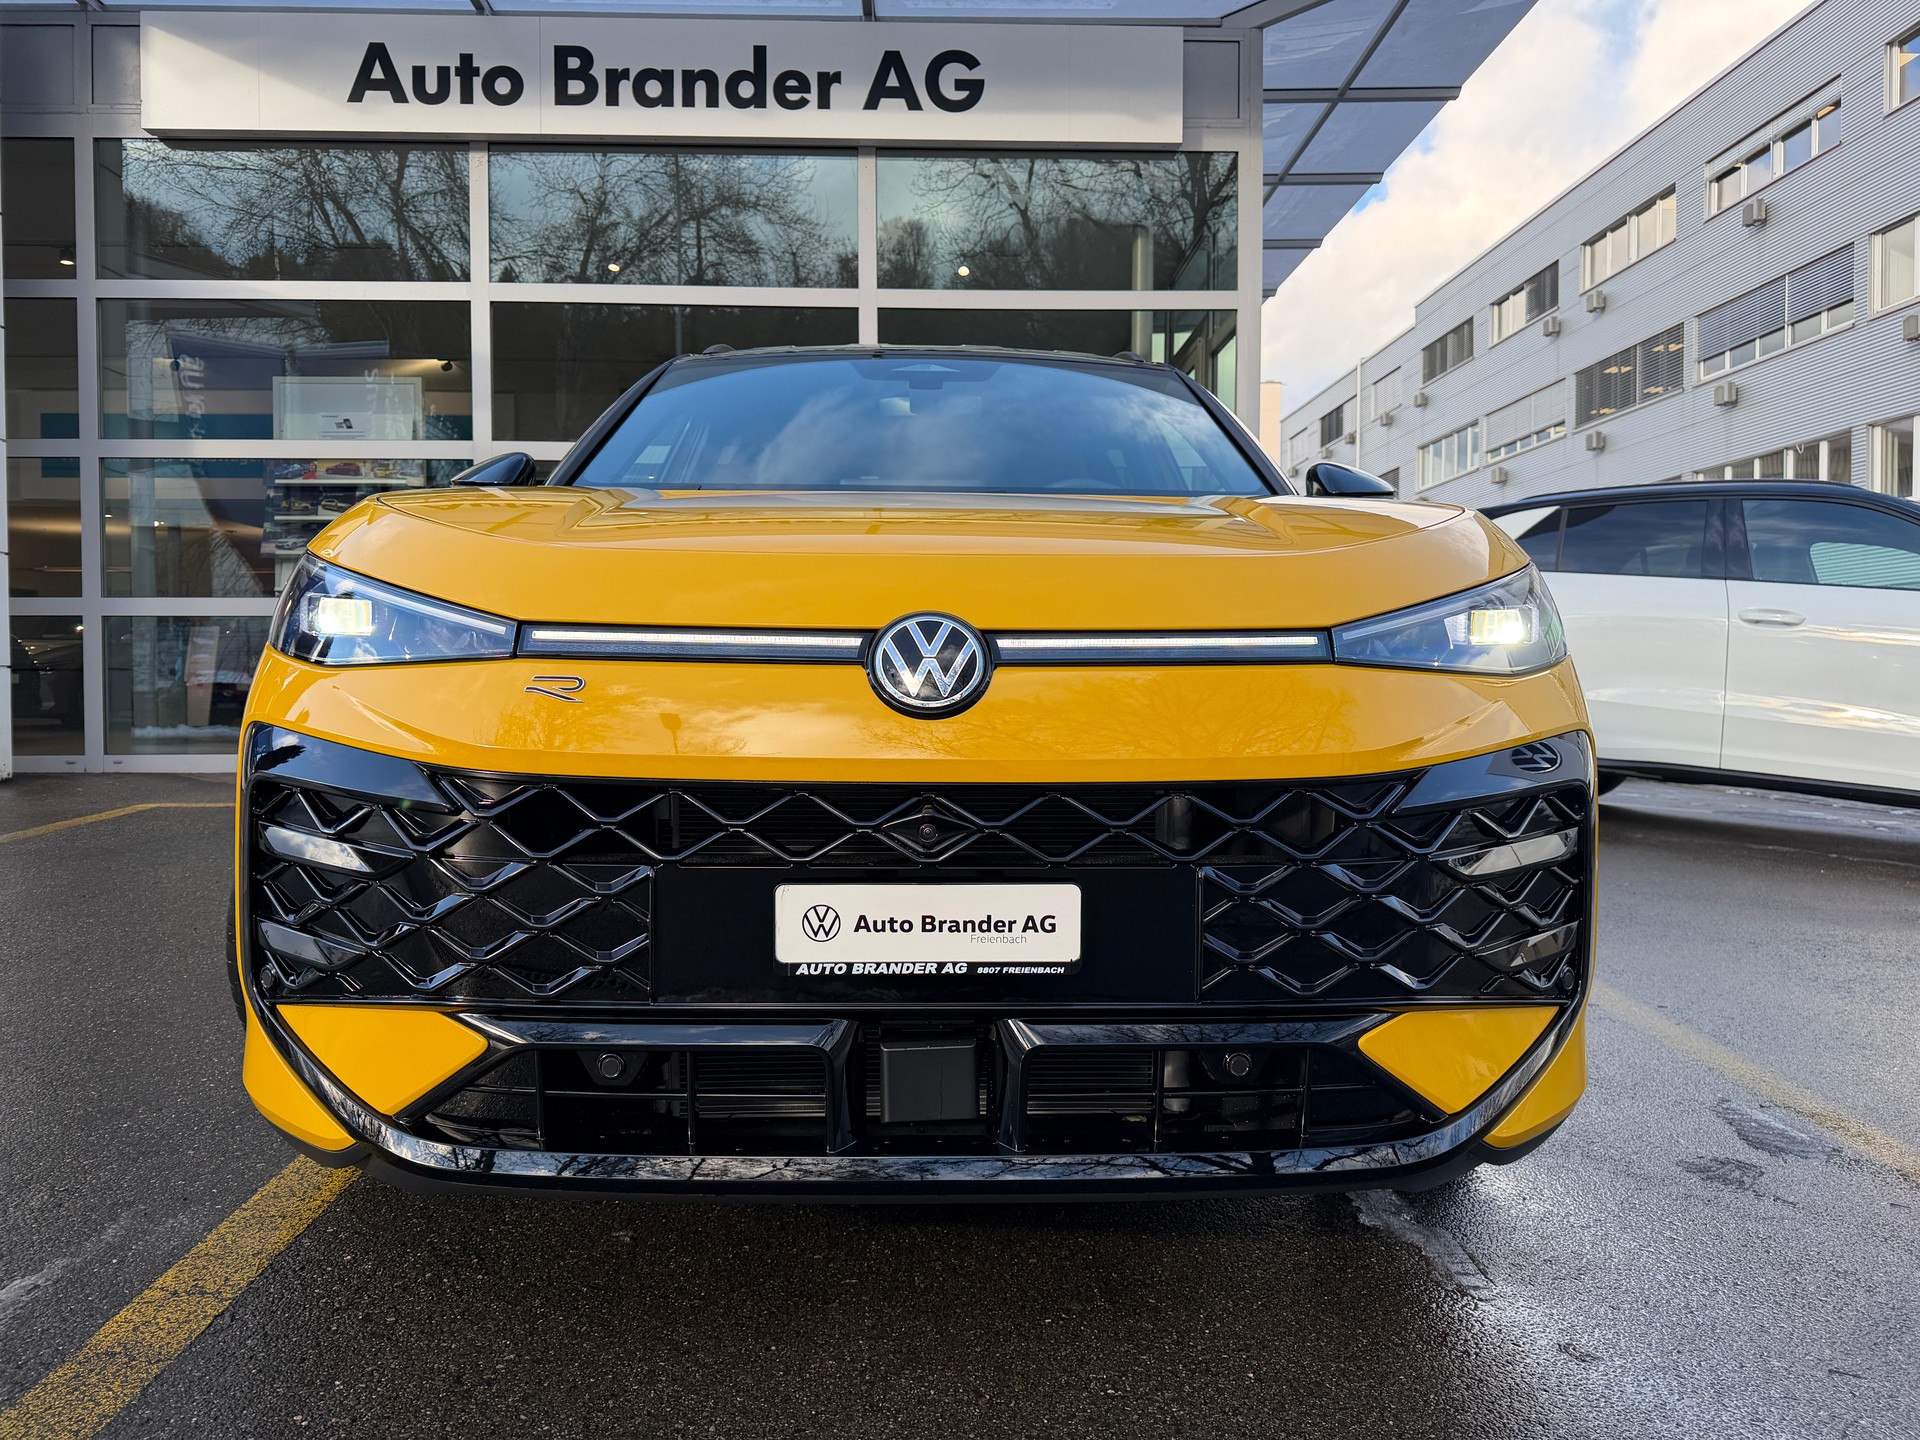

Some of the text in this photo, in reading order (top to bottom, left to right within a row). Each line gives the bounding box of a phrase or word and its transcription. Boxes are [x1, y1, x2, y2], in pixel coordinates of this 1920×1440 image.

[346, 42, 986, 113] Auto Brander AG
[853, 914, 1057, 934] Auto Brander AG
[970, 934, 1027, 944] Freienbach
[796, 962, 1065, 975] AUTO BRANDER AG 8807 FREIENBACH
